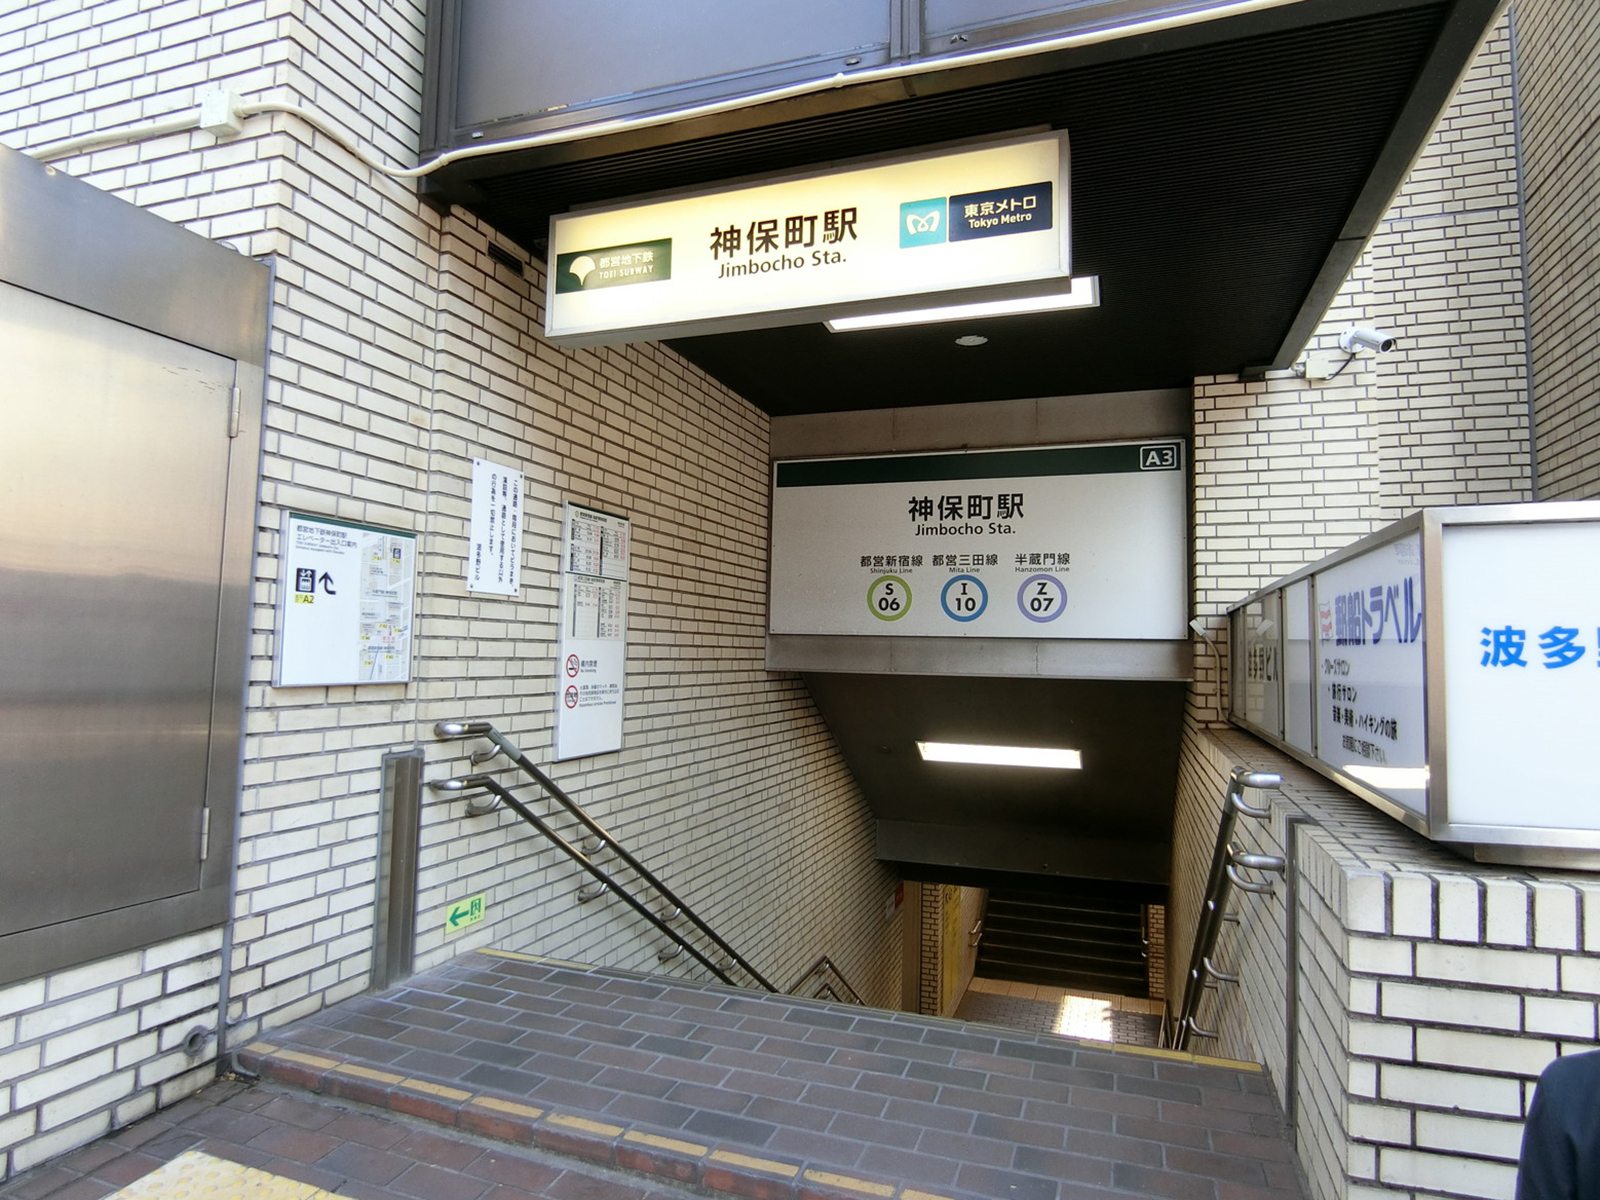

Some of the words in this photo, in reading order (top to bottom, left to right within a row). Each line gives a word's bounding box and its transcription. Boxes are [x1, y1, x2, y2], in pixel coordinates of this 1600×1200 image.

[964, 196, 1036, 218] 東京メトロ
[968, 218, 998, 229] Tokyo
[1001, 213, 1032, 224] Metro
[709, 206, 858, 260] 神保町駅
[599, 251, 654, 269] 都営地下鉄
[718, 254, 805, 279] Jimbocho
[812, 250, 846, 266] Sta.
[599, 269, 616, 279] TOEI
[619, 265, 653, 277] SUBWAY
[1145, 450, 1173, 466] A3
[908, 493, 1024, 521] 神保町駅
[915, 522, 983, 536] Jimbocho
[988, 522, 1016, 534] Sta.
[860, 554, 923, 567] 都営新宿線
[931, 553, 998, 566] 都営三田線
[1014, 552, 1071, 566] 半蔵門線
[885, 583, 894, 596] S
[960, 582, 968, 595] I
[1036, 582, 1048, 596] Z
[303, 594, 314, 604] A2
[878, 597, 900, 612] 06
[955, 597, 976, 612] 10
[1030, 597, 1054, 612] 07
[1480, 625, 1600, 669] 波多
